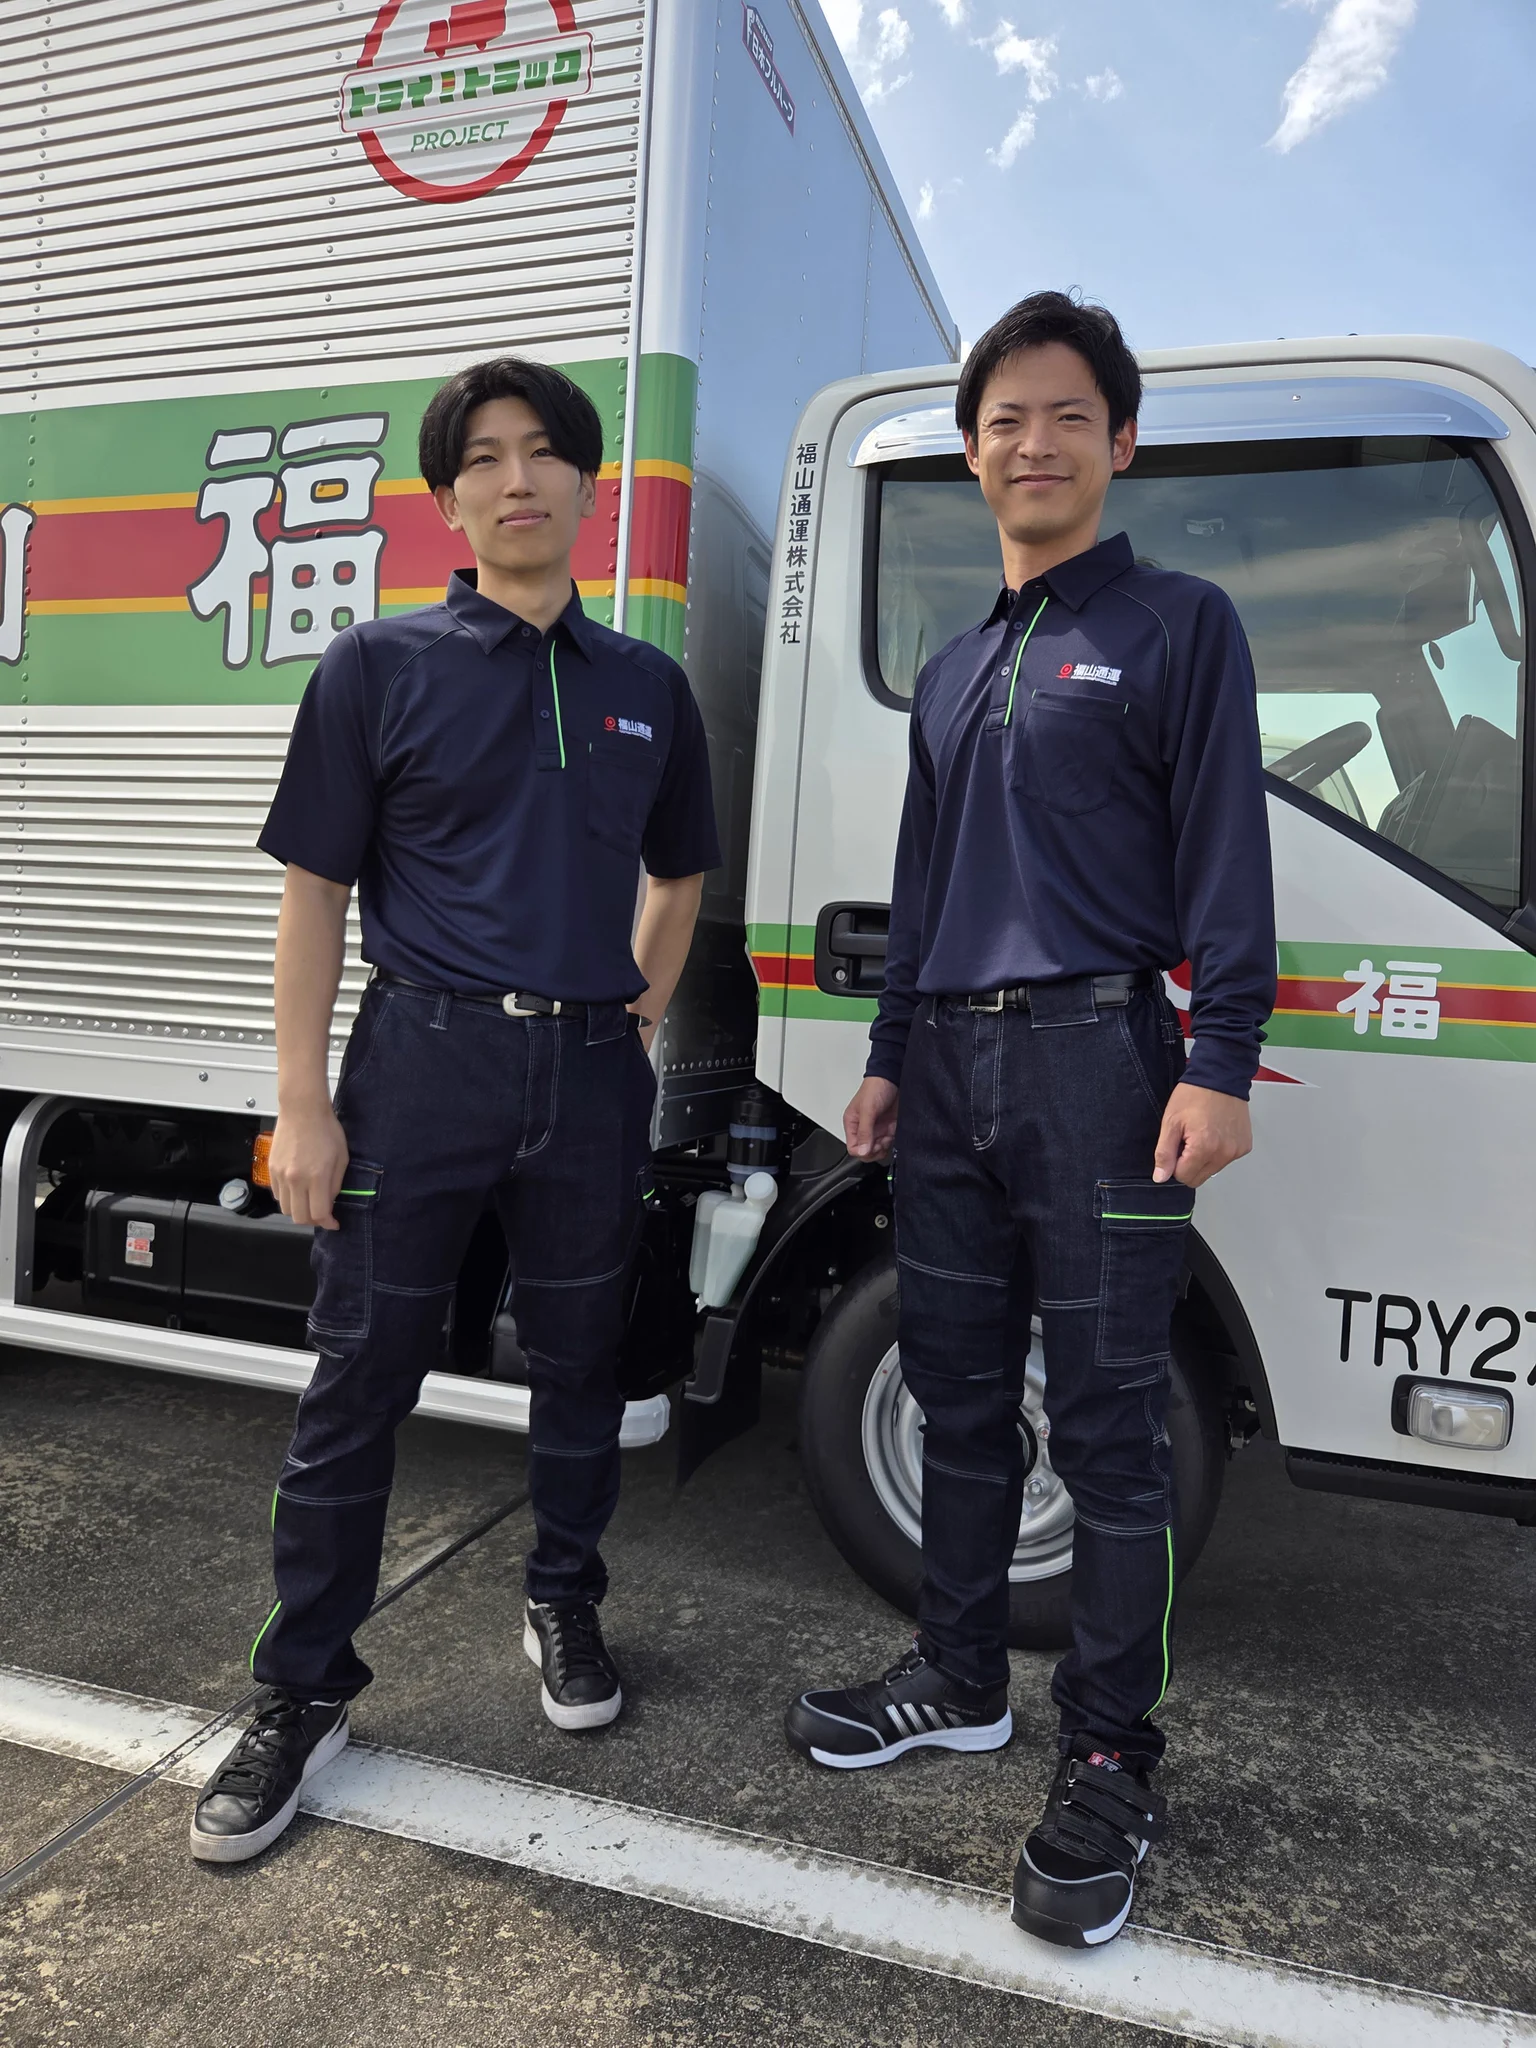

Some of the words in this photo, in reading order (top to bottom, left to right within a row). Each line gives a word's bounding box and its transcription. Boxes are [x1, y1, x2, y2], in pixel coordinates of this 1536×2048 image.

[752, 32, 794, 121] 日本フルハーフ
[410, 120, 509, 152] PROJECT
[779, 443, 818, 644] 福山通運株式会社
[1336, 959, 1442, 1040] 福
